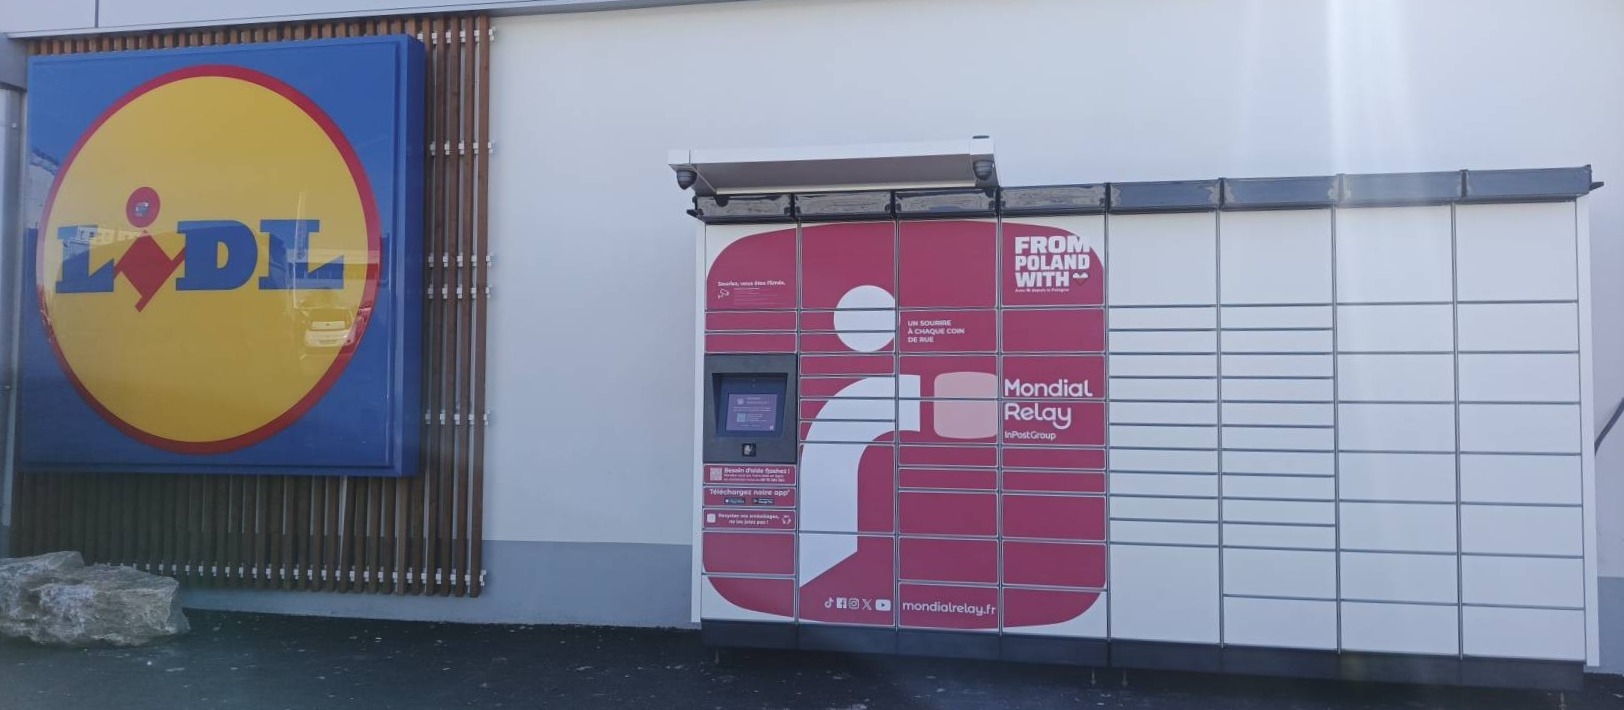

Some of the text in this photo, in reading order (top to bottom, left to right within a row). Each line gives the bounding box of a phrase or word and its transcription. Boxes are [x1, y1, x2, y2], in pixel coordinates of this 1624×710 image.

[1015, 236, 1090, 254] FROM
[1015, 254, 1090, 270] POLAND
[1015, 271, 1069, 287] WITH
[1004, 378, 1093, 397] Mondial
[1004, 402, 1071, 430] Relay
[1004, 430, 1056, 440] InPostGroup
[903, 602, 996, 616] mondialrelay.fr
